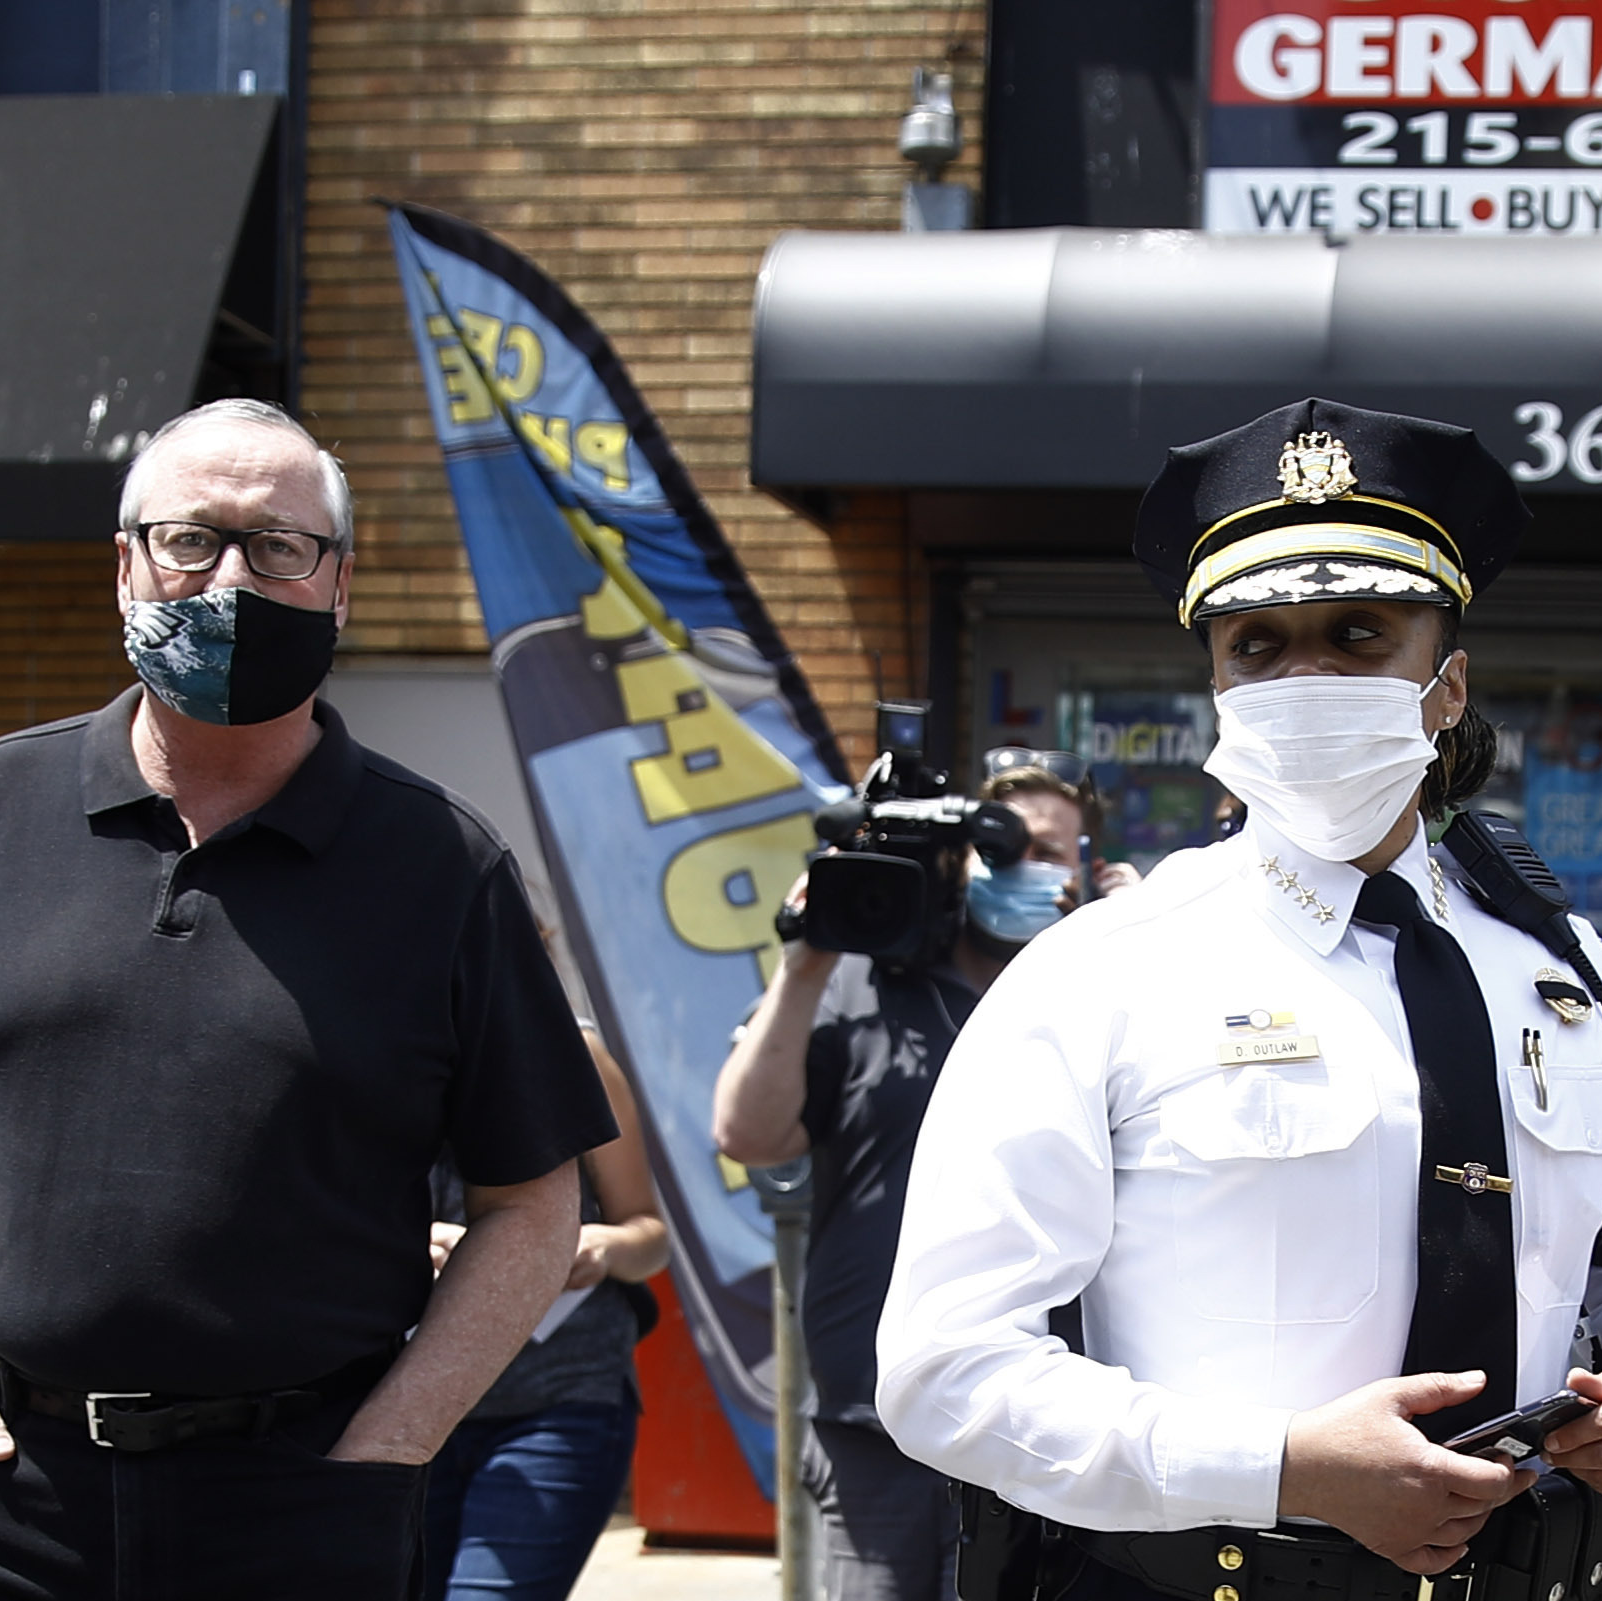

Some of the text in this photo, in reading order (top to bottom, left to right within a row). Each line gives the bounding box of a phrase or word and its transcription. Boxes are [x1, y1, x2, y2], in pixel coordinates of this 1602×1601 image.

[1250, 187, 1335, 229] WE
[1358, 187, 1460, 230] SELL
[1254, 1041, 1297, 1056] OUTLAW
